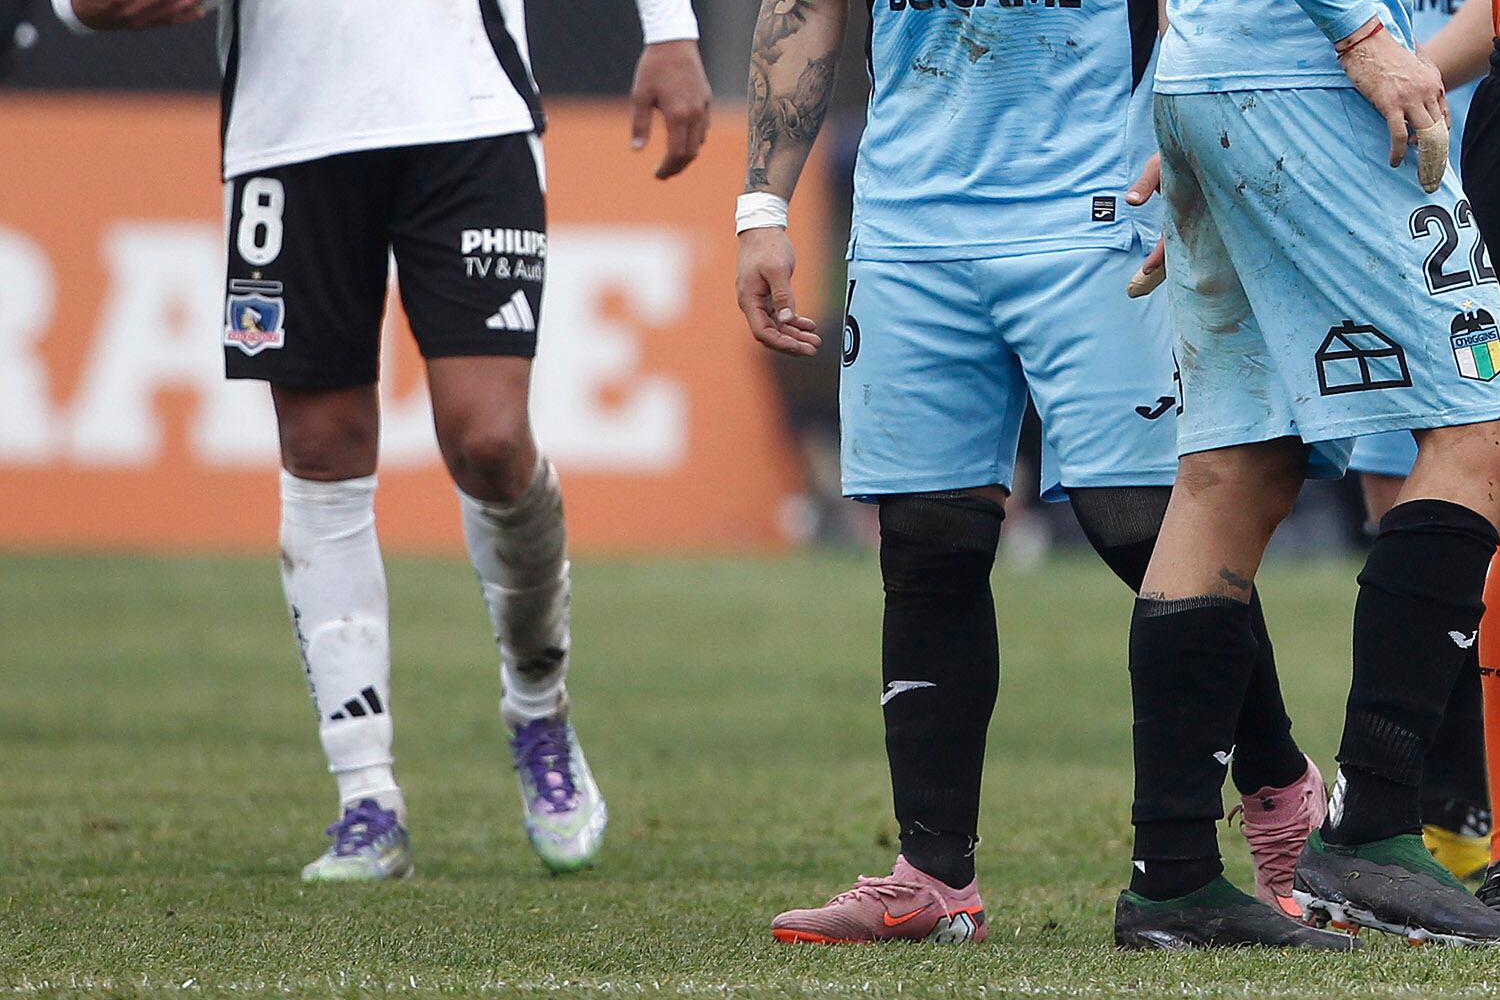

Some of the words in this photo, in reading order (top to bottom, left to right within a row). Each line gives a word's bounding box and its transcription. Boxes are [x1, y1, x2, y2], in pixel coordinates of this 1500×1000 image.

[237, 177, 285, 266] 8
[1408, 199, 1500, 296] 22
[463, 257, 492, 278] TV
[495, 257, 512, 279] &
[1455, 330, 1497, 347] O'HIGGINS
